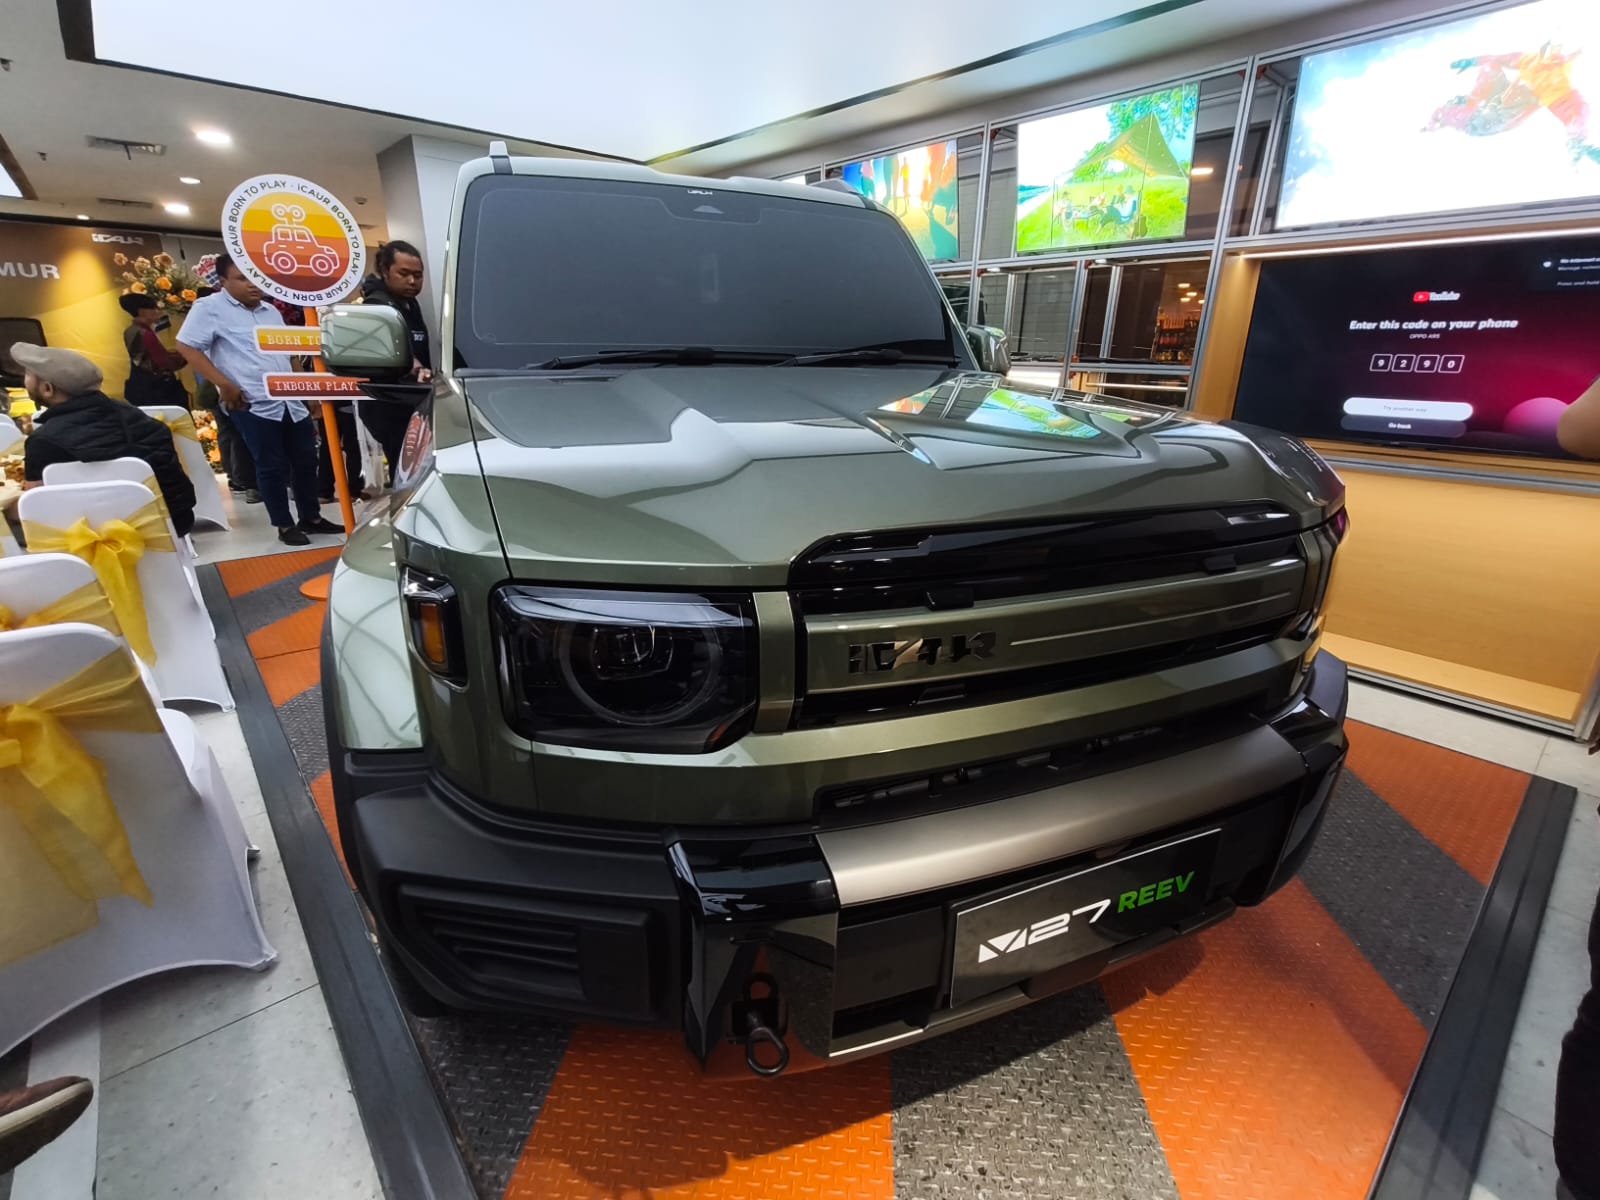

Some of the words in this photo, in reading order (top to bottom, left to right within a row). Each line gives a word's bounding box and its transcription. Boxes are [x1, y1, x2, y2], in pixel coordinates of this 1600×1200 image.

[228, 195, 247, 223] BORN
[243, 186, 259, 197] TO
[259, 180, 287, 190] PLAY
[331, 205, 355, 233] BORN
[350, 234, 360, 249] TO
[351, 251, 361, 276] PLAY
[246, 267, 273, 289] PLAY
[274, 286, 289, 298] TO
[292, 293, 324, 302] BORN
[1349, 320, 1378, 330] Enter
[1379, 320, 1400, 330] this
[1402, 320, 1429, 330] code
[1431, 321, 1446, 329] on
[1449, 320, 1476, 331] your
[1478, 318, 1519, 331] phone
[267, 335, 301, 346] BORN
[274, 381, 320, 391] INBORN
[1117, 871, 1195, 913] REEV
